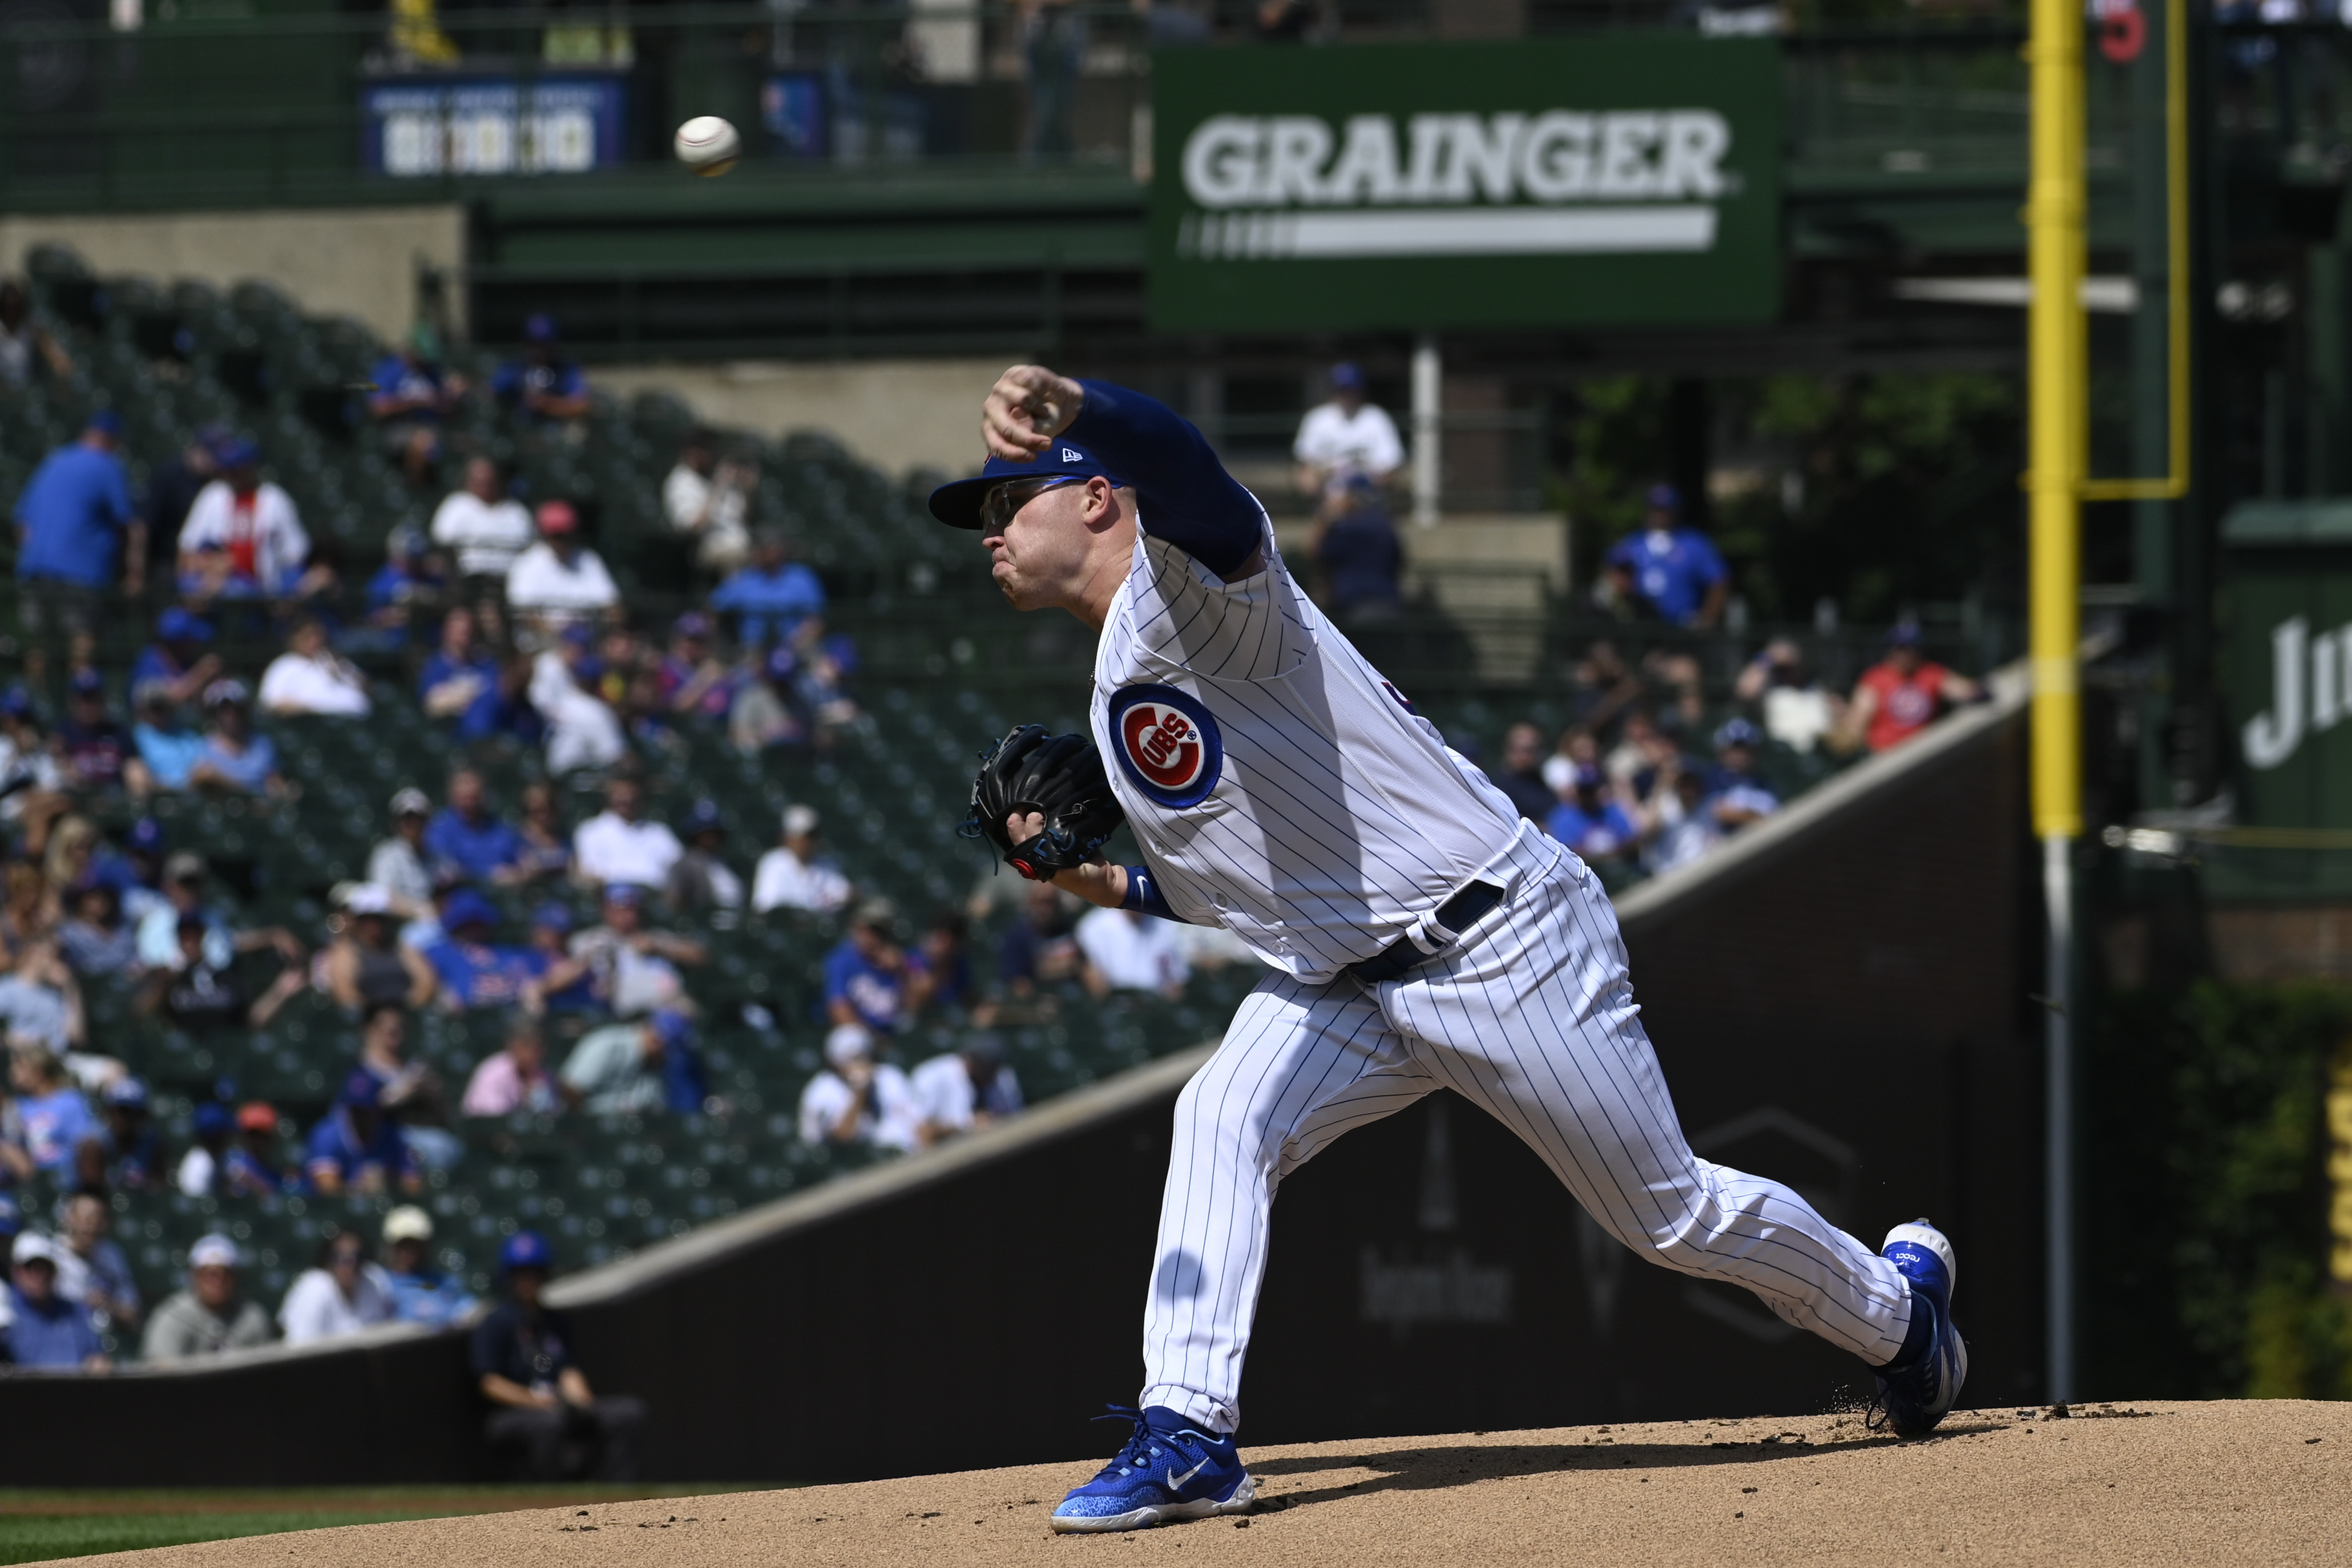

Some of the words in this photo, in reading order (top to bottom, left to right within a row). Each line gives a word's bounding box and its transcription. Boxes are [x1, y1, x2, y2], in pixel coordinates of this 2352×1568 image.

[1181, 110, 1730, 207] GRAINGER
[1124, 707, 1199, 786] CUBS
[1895, 1253, 1921, 1263] react
